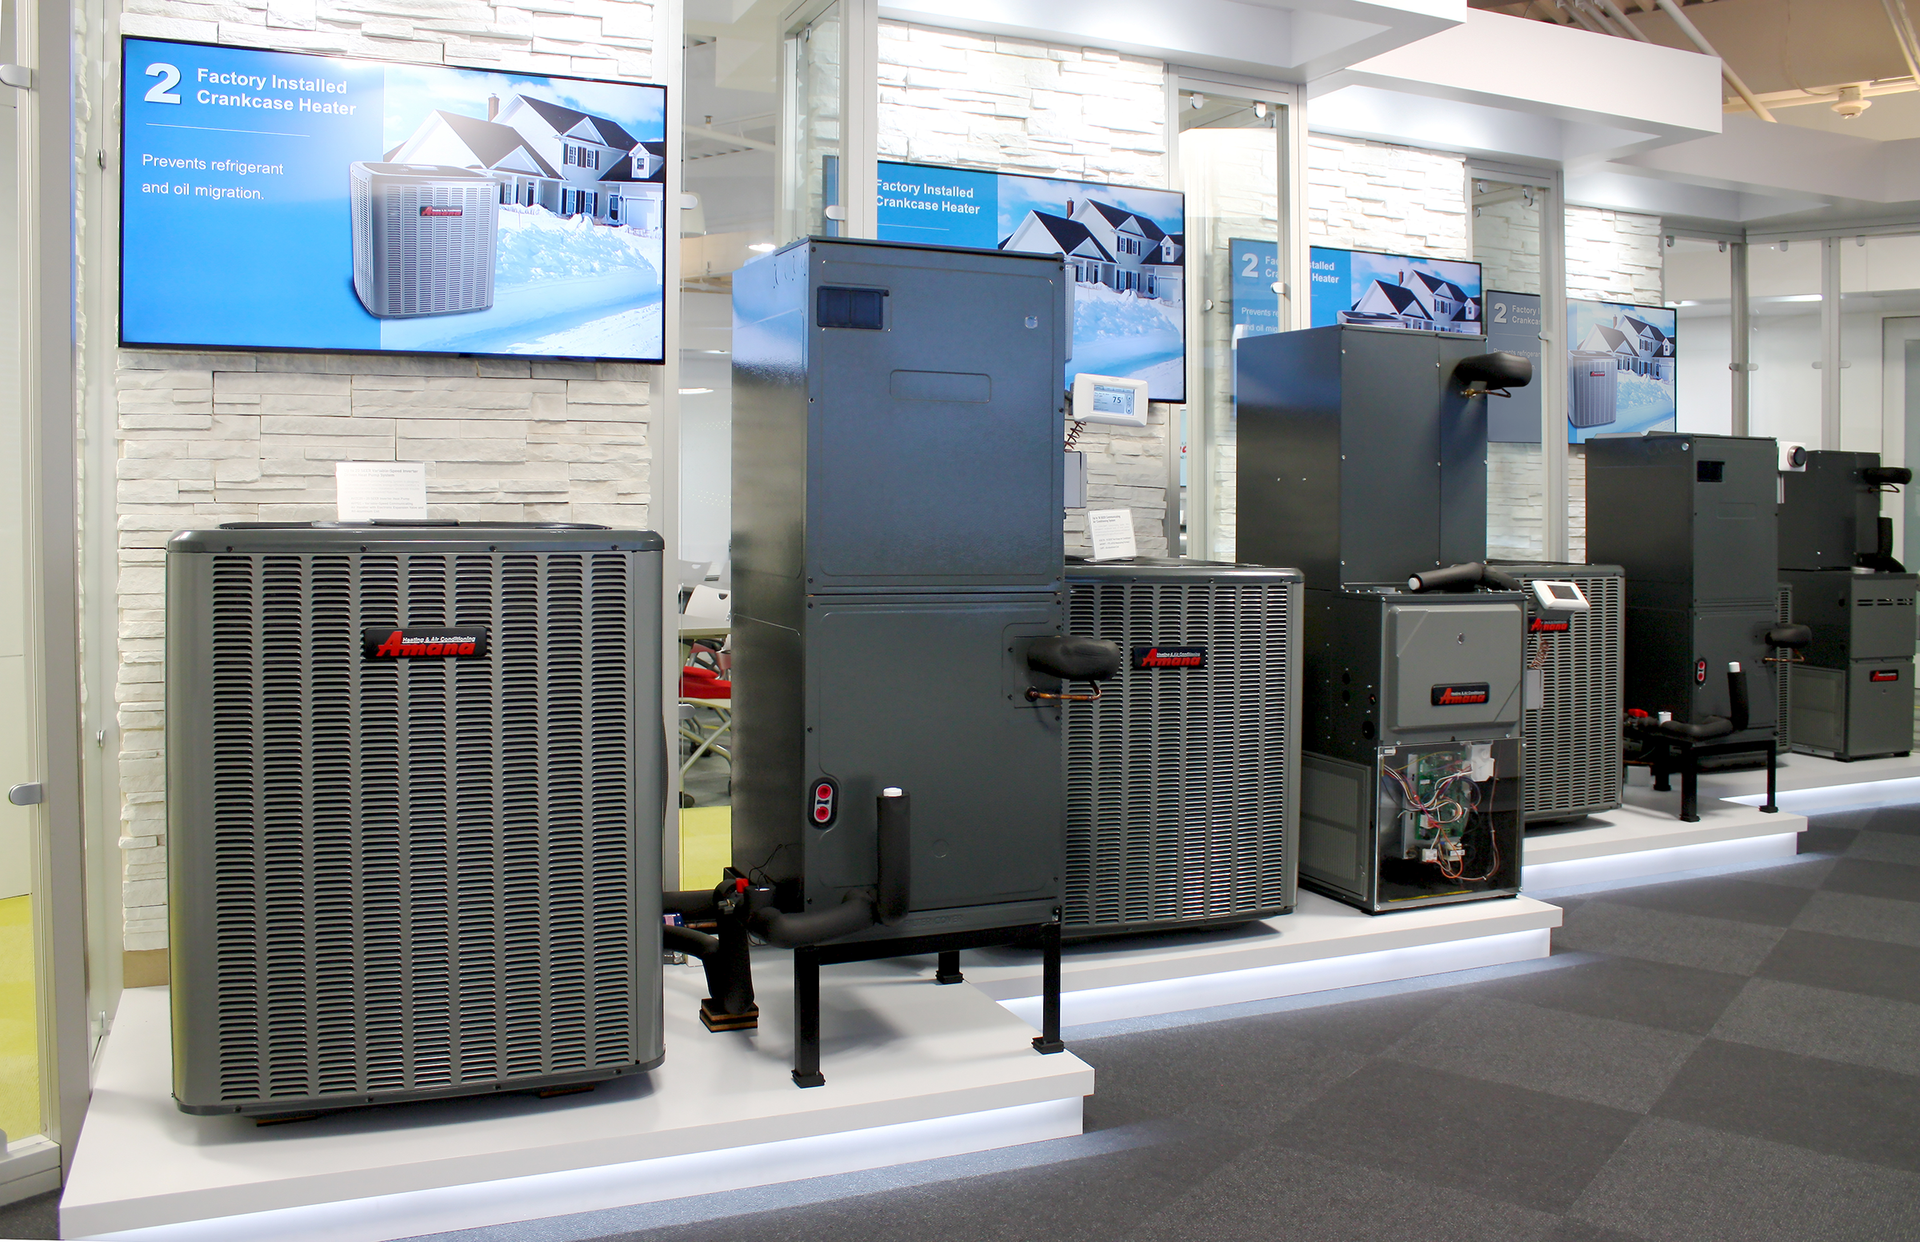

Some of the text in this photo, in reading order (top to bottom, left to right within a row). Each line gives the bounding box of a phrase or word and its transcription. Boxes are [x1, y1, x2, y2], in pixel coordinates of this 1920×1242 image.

[144, 63, 182, 104] 2
[198, 68, 347, 94] Factory Installed
[197, 90, 356, 115] Crankcase Heater
[142, 154, 284, 176] Prevents refrigerant
[142, 182, 264, 200] and oil migration.
[924, 184, 974, 198] Installed
[877, 196, 980, 214] Crankcase Heater
[1242, 253, 1258, 278] 2
[1312, 274, 1339, 283] Heater
[1242, 307, 1271, 316] Prevents
[1494, 303, 1507, 323] 2
[1512, 305, 1537, 316] Factory
[376, 630, 476, 656] Amana
[1141, 648, 1201, 666] Amana
[1439, 688, 1486, 704] Amana
